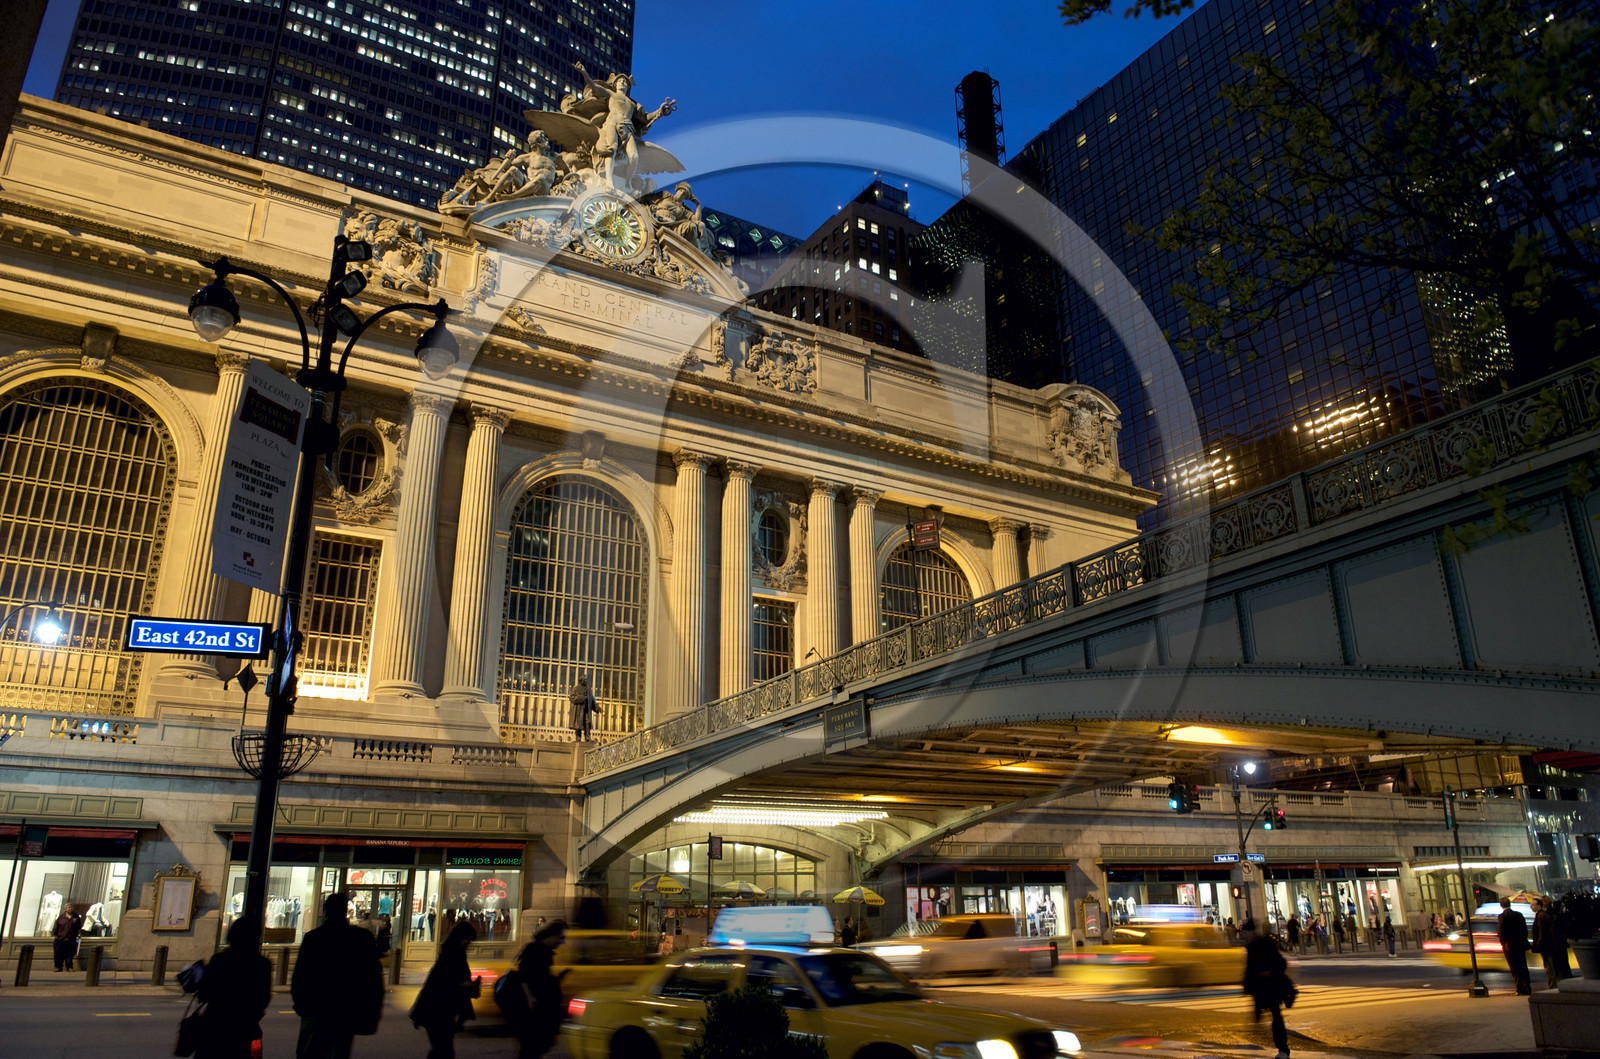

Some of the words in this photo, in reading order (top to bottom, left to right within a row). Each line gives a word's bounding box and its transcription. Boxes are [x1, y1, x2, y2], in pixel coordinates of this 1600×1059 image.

[523, 270, 592, 298] GRAND
[605, 293, 688, 326] CENTRAL
[561, 293, 654, 329] TERMINAL
[252, 375, 292, 402] WELCOME
[293, 397, 304, 409] TO
[250, 397, 296, 425] PERSHING
[252, 410, 288, 432] SQUARE
[250, 432, 279, 451] PLAZA
[231, 460, 264, 478] PROMENADE
[264, 473, 286, 488] SEATING
[251, 459, 270, 472] PUBLIC
[236, 471, 250, 482] OPEN
[250, 477, 279, 493] WEEKDAYS
[234, 494, 260, 510] OUTDOOR
[260, 489, 272, 499] 3PM
[230, 510, 245, 522] NOON
[266, 524, 274, 532] PM
[232, 502, 246, 512] OPEN
[246, 508, 274, 524] WEEKDAYS
[230, 525, 242, 535] MAY
[246, 531, 270, 546] OCTOBER
[136, 627, 180, 644] East
[184, 630, 230, 646] 42nd
[235, 632, 256, 648] St
[831, 709, 858, 722] PERSHING
